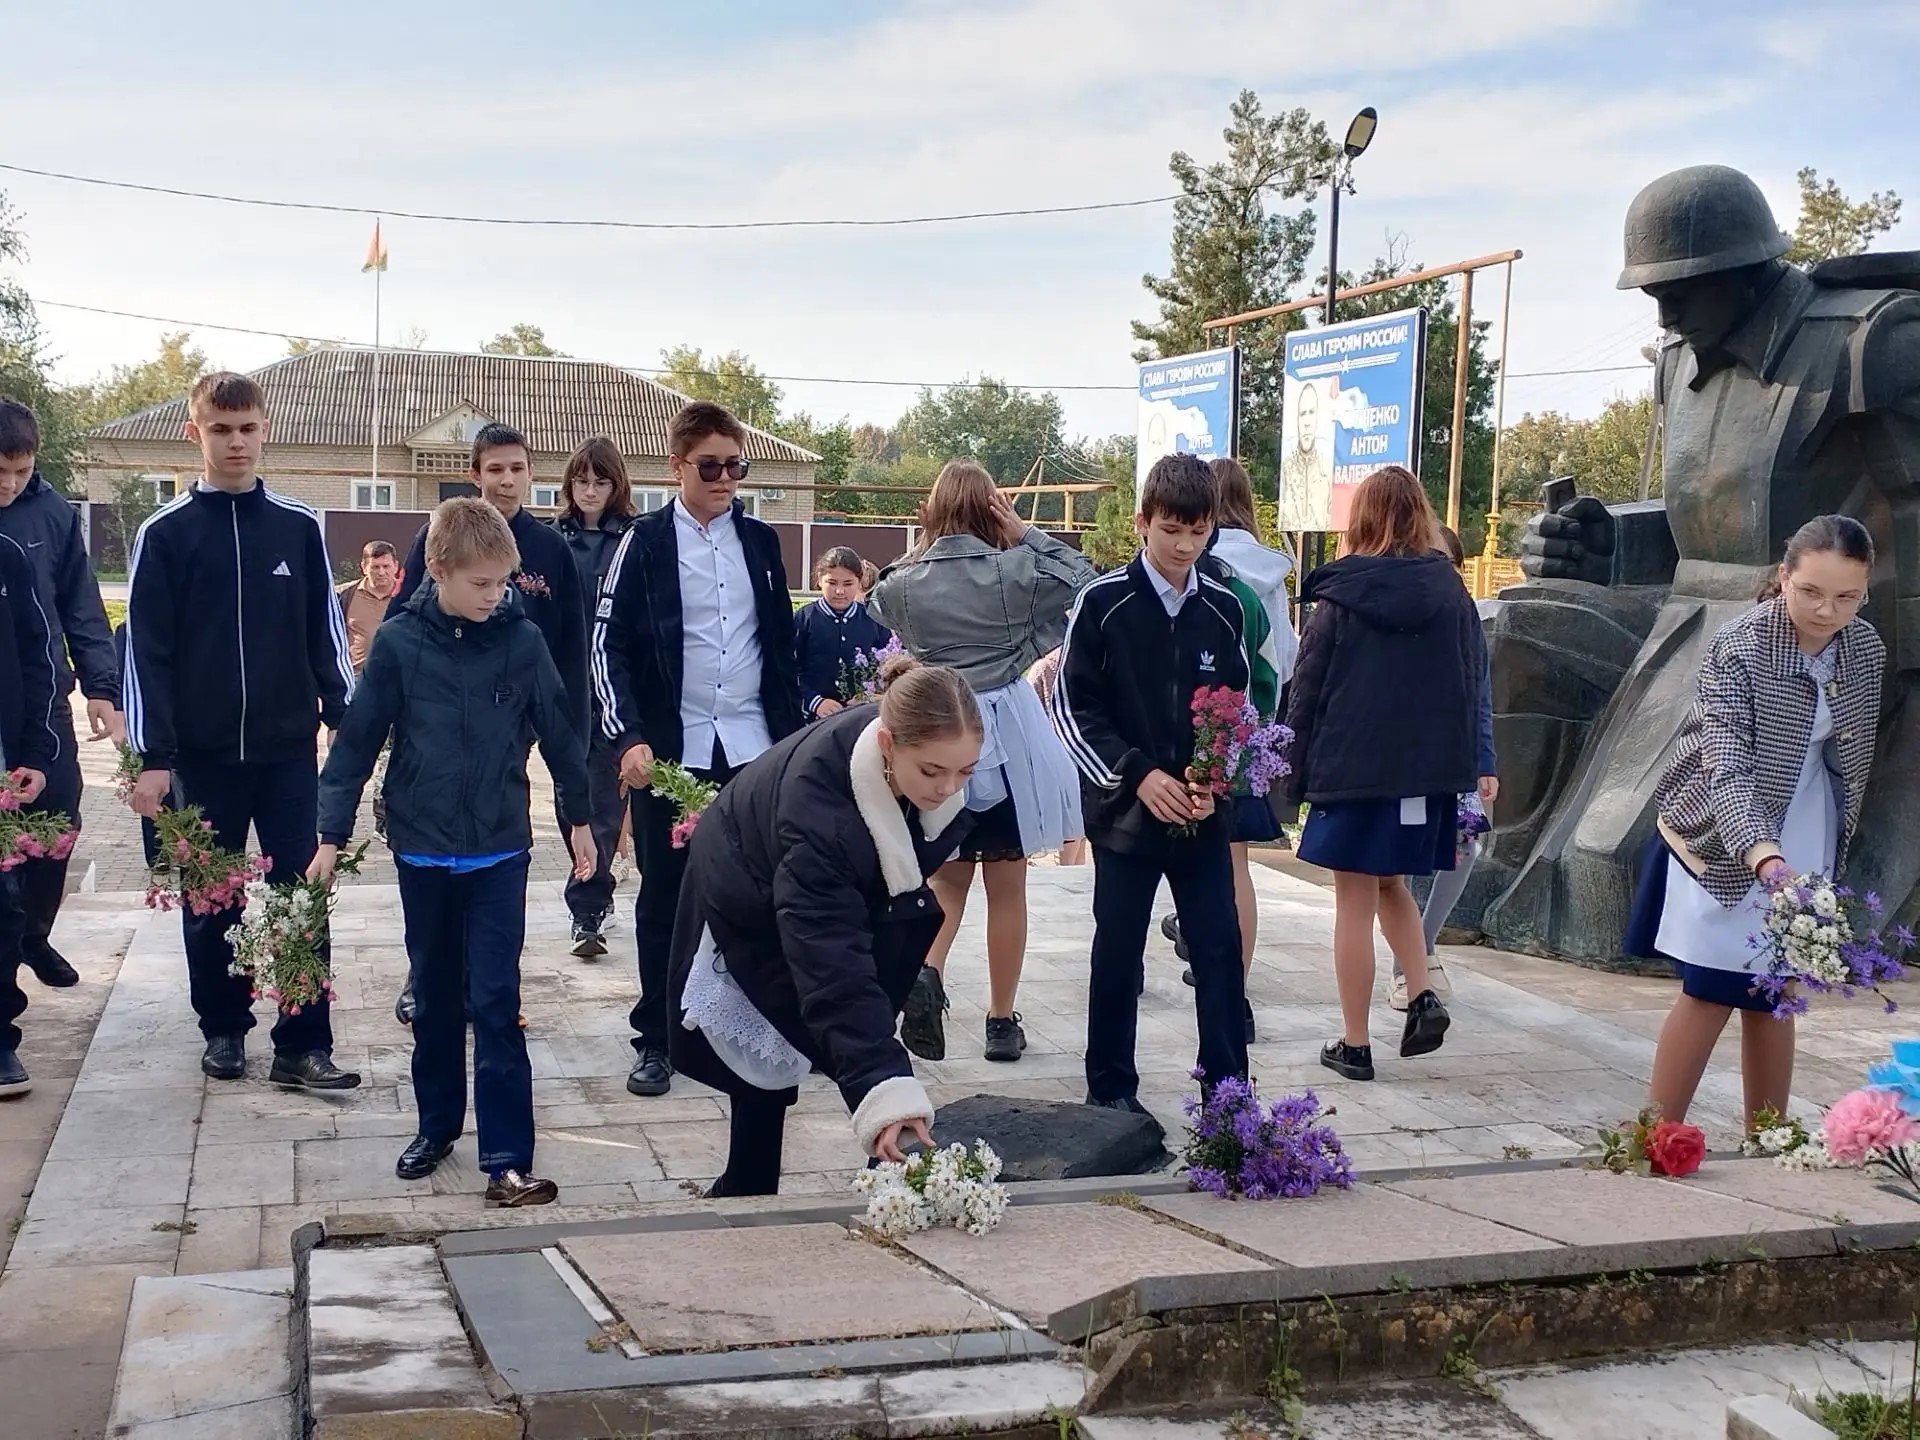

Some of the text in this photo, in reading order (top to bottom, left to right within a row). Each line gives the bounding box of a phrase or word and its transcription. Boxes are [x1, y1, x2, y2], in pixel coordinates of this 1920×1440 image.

[1291, 325, 1408, 362] СЛАВА ГЕРОЯМ РОССИИ!
[1350, 434, 1389, 456] АНТОН
